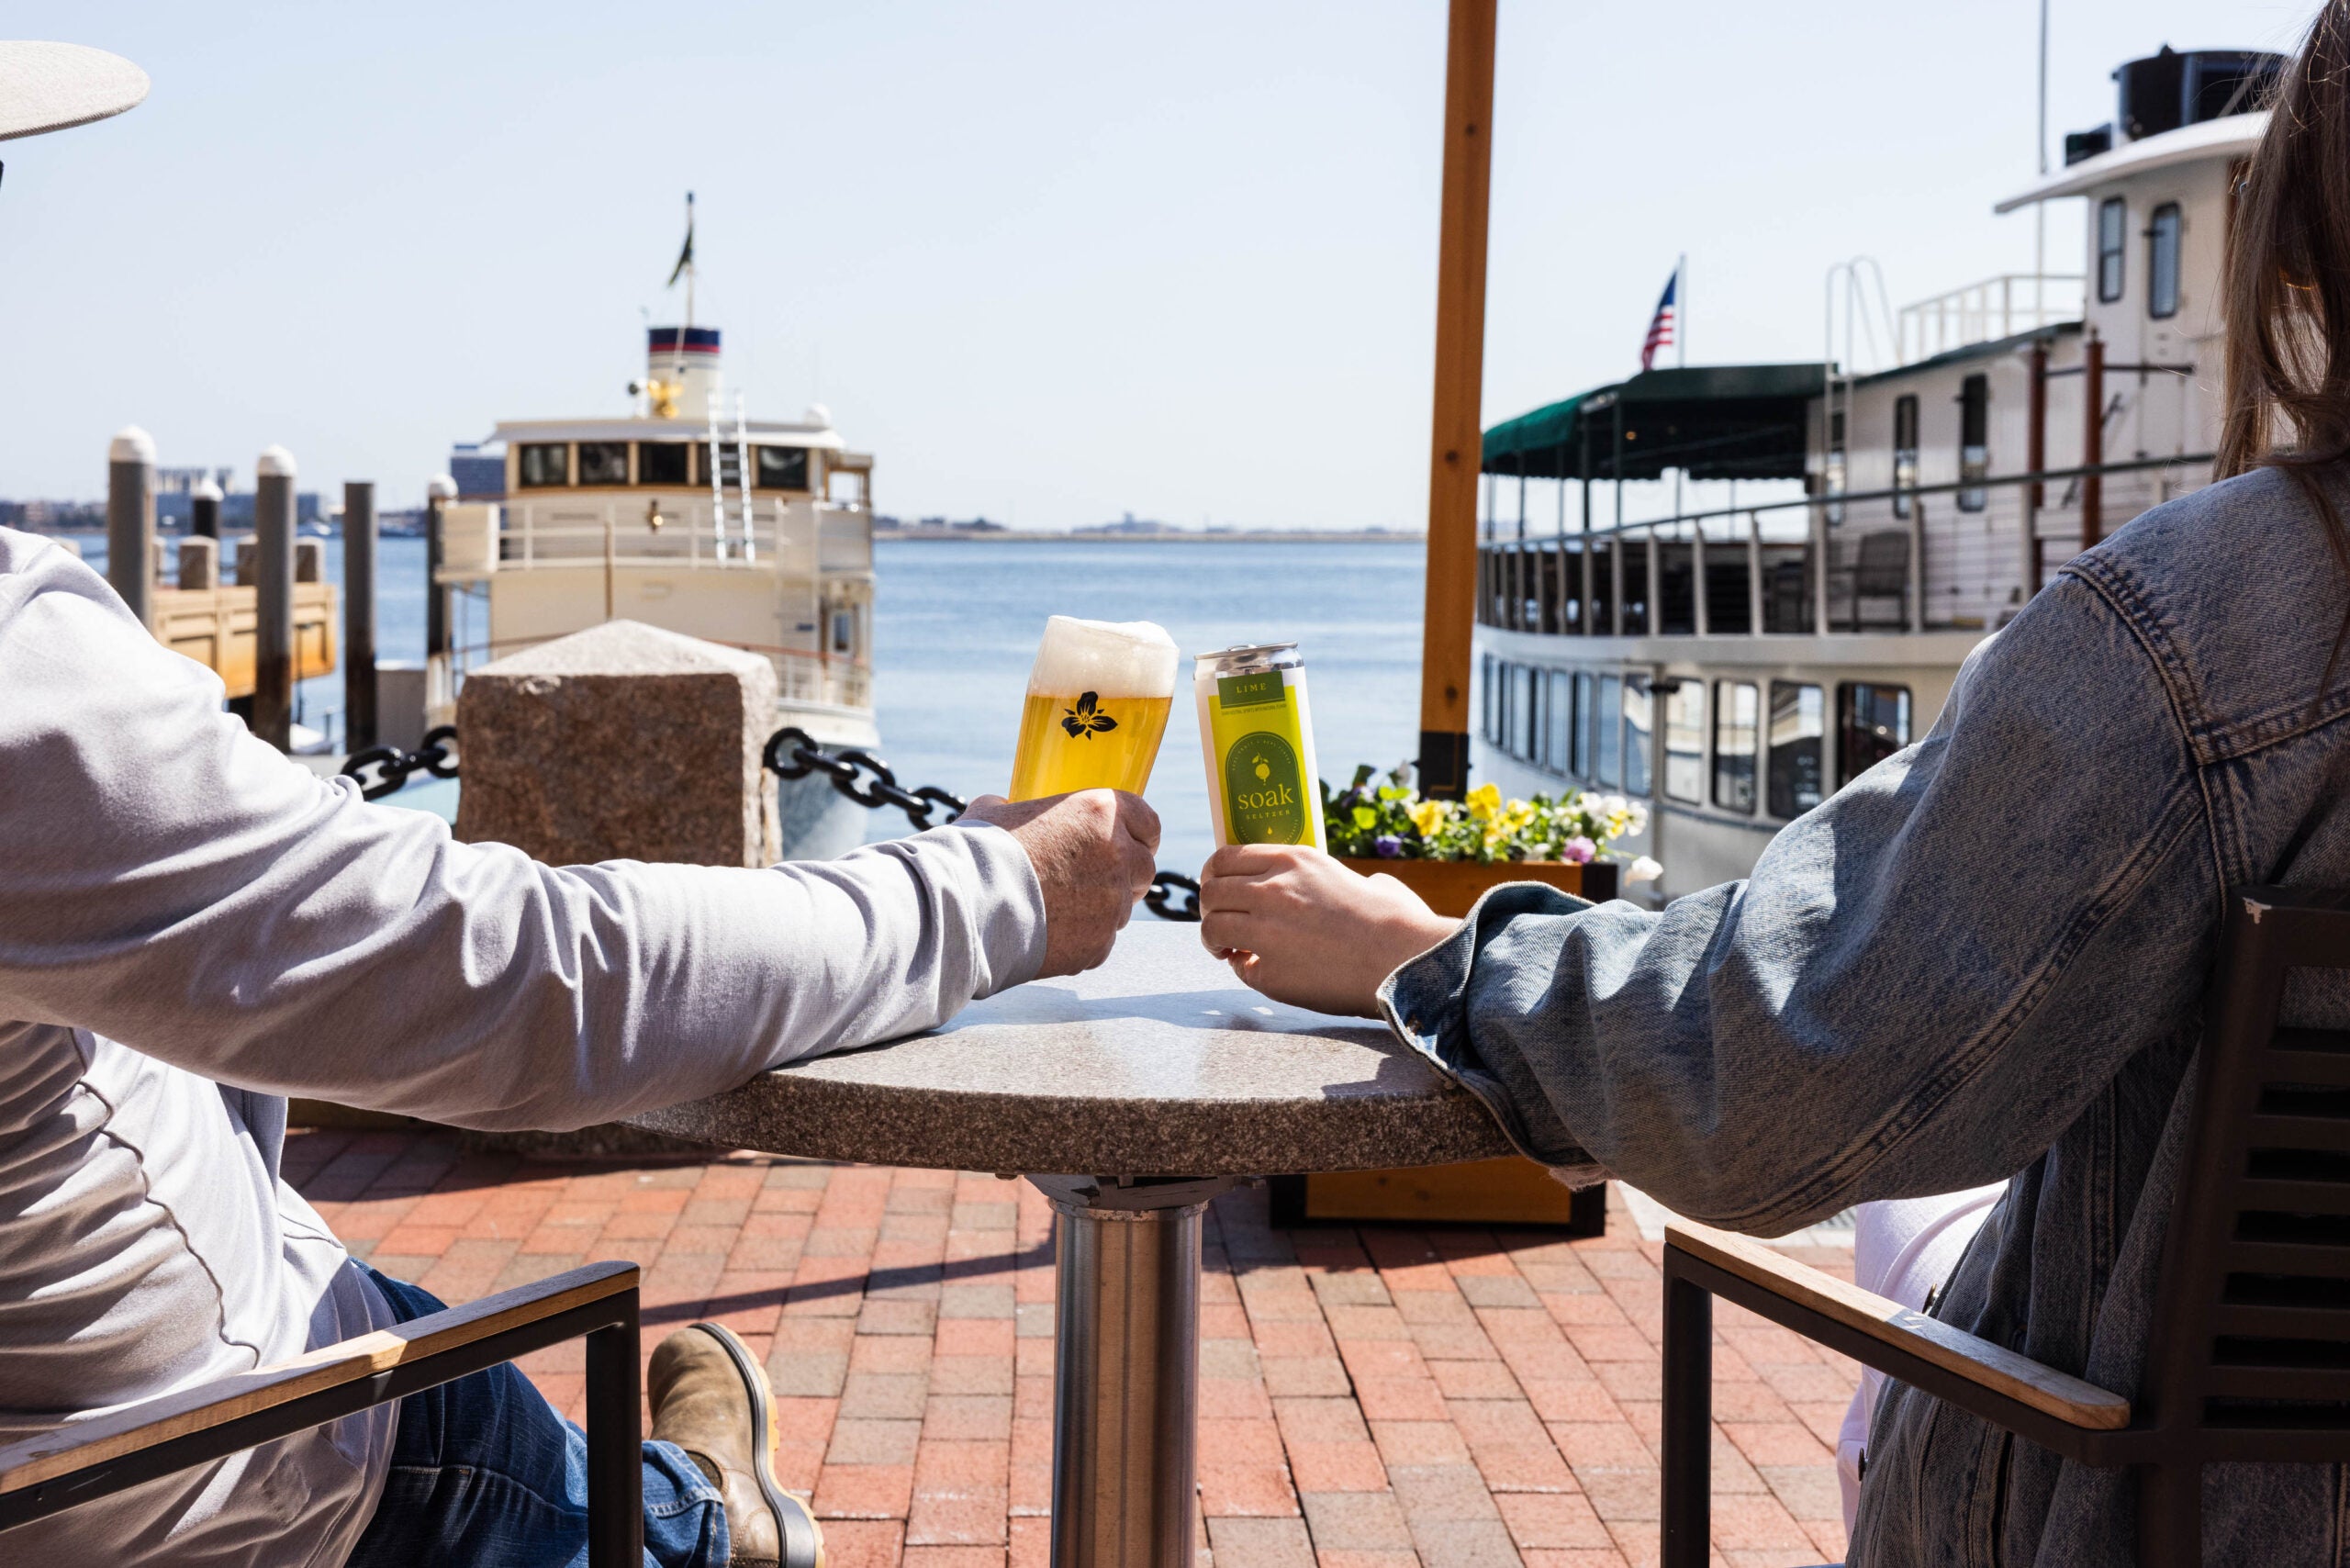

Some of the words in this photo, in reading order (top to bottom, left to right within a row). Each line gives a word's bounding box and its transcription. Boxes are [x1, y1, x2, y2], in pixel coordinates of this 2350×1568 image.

[1237, 682, 1267, 694] LIME
[1238, 782, 1294, 810] soak
[1246, 809, 1291, 820] SELTZER
